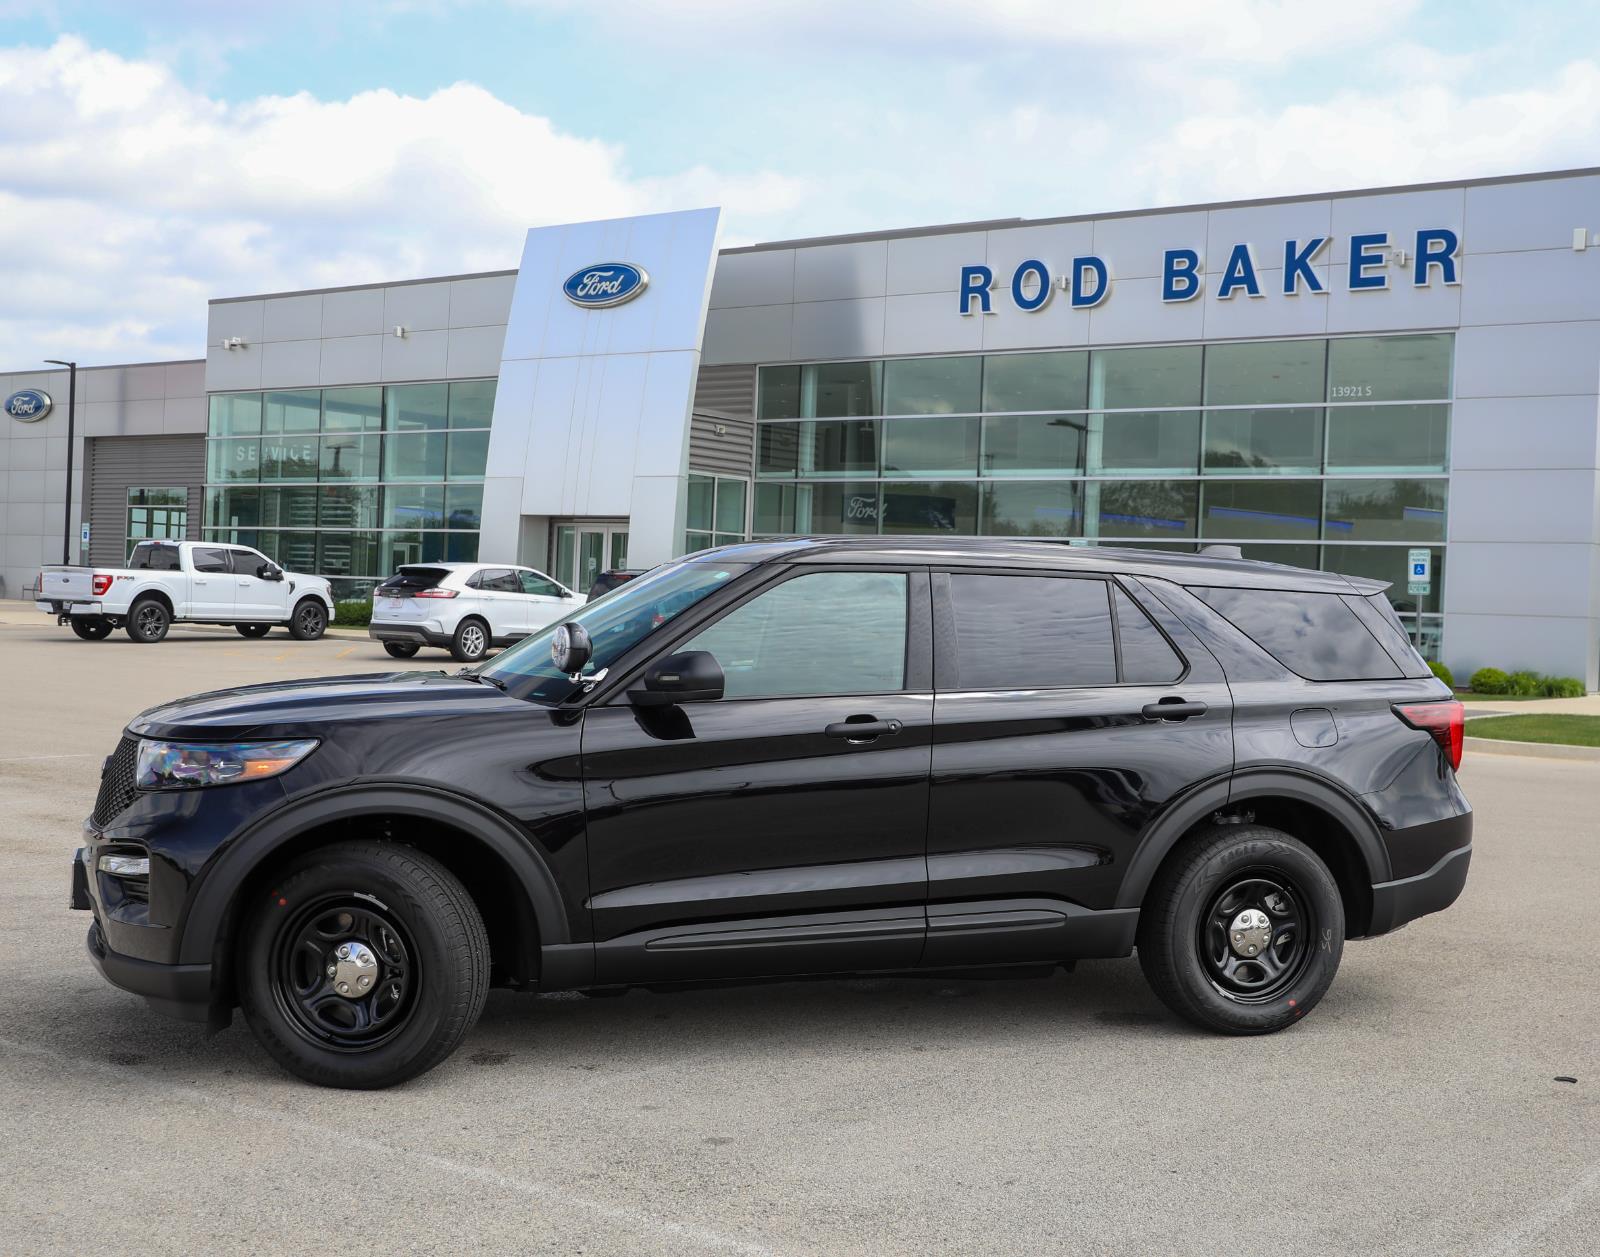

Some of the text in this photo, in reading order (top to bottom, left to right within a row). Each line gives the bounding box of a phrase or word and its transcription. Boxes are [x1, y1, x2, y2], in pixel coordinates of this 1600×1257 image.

[959, 228, 1460, 314] ROD BAKER
[577, 271, 625, 297] Ford
[1331, 385, 1372, 397] 13921 S
[11, 396, 36, 414] Ford
[236, 445, 311, 461] SEVICE
